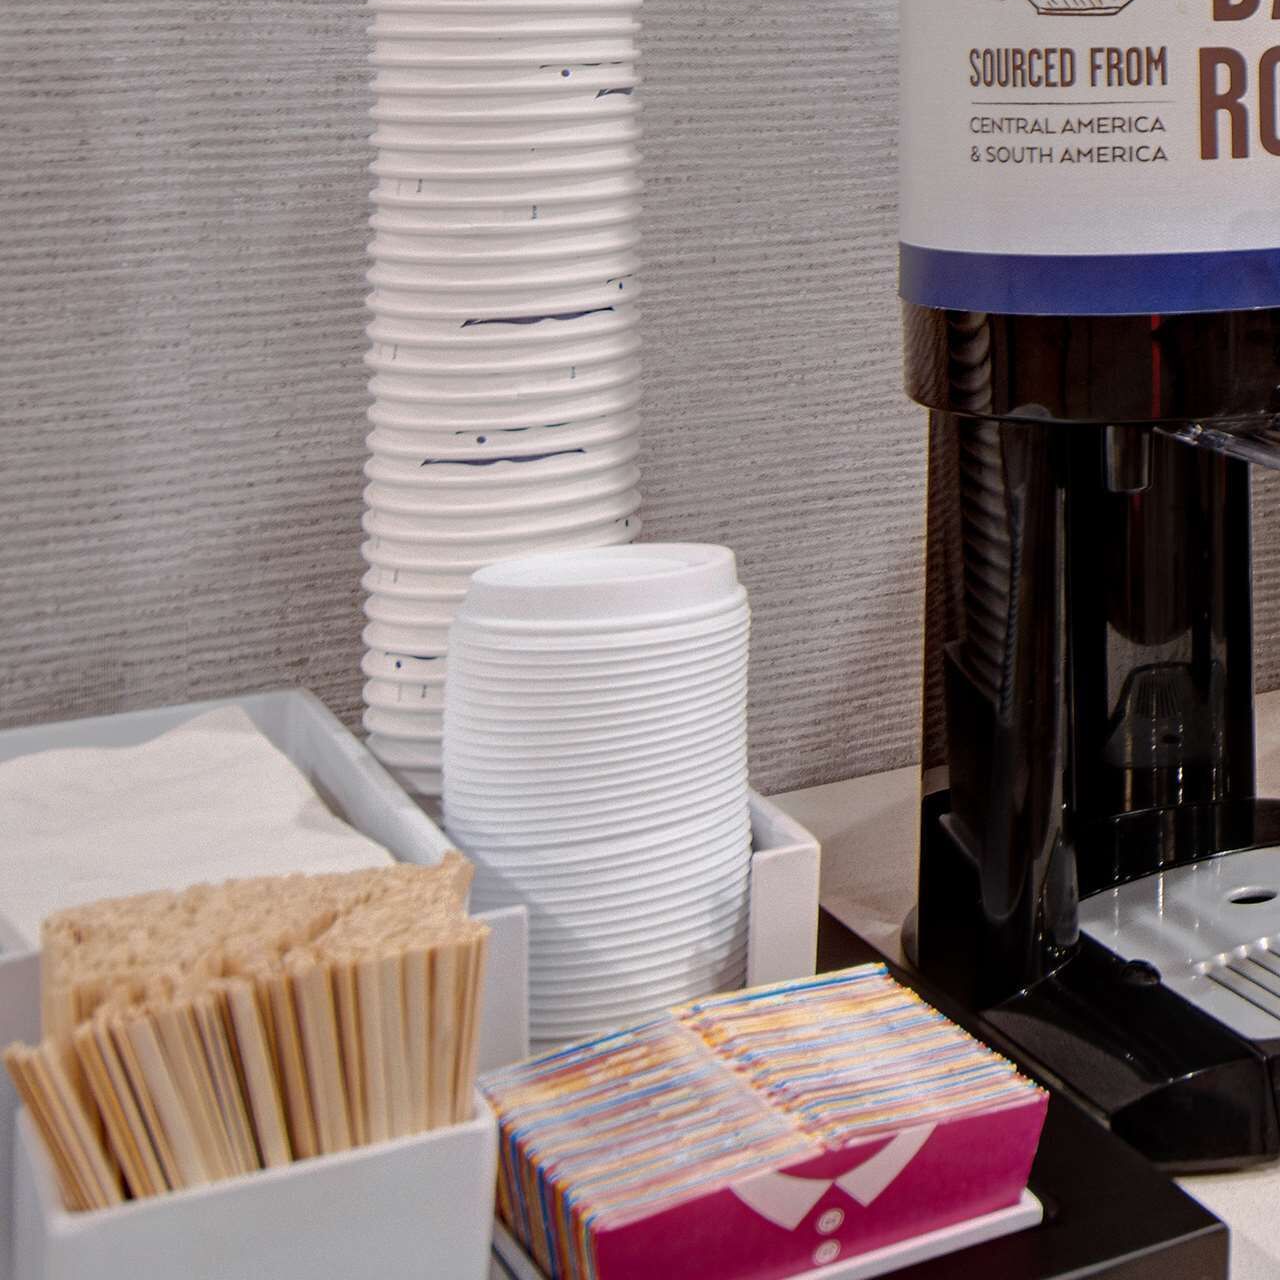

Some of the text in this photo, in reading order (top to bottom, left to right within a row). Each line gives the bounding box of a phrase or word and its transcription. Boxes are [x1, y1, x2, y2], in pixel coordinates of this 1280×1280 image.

[969, 46, 1167, 88] SOURCED FROM
[970, 116, 1166, 134] CENTRAL AMERICA
[971, 146, 1168, 163] & SOUTH AMERICA
